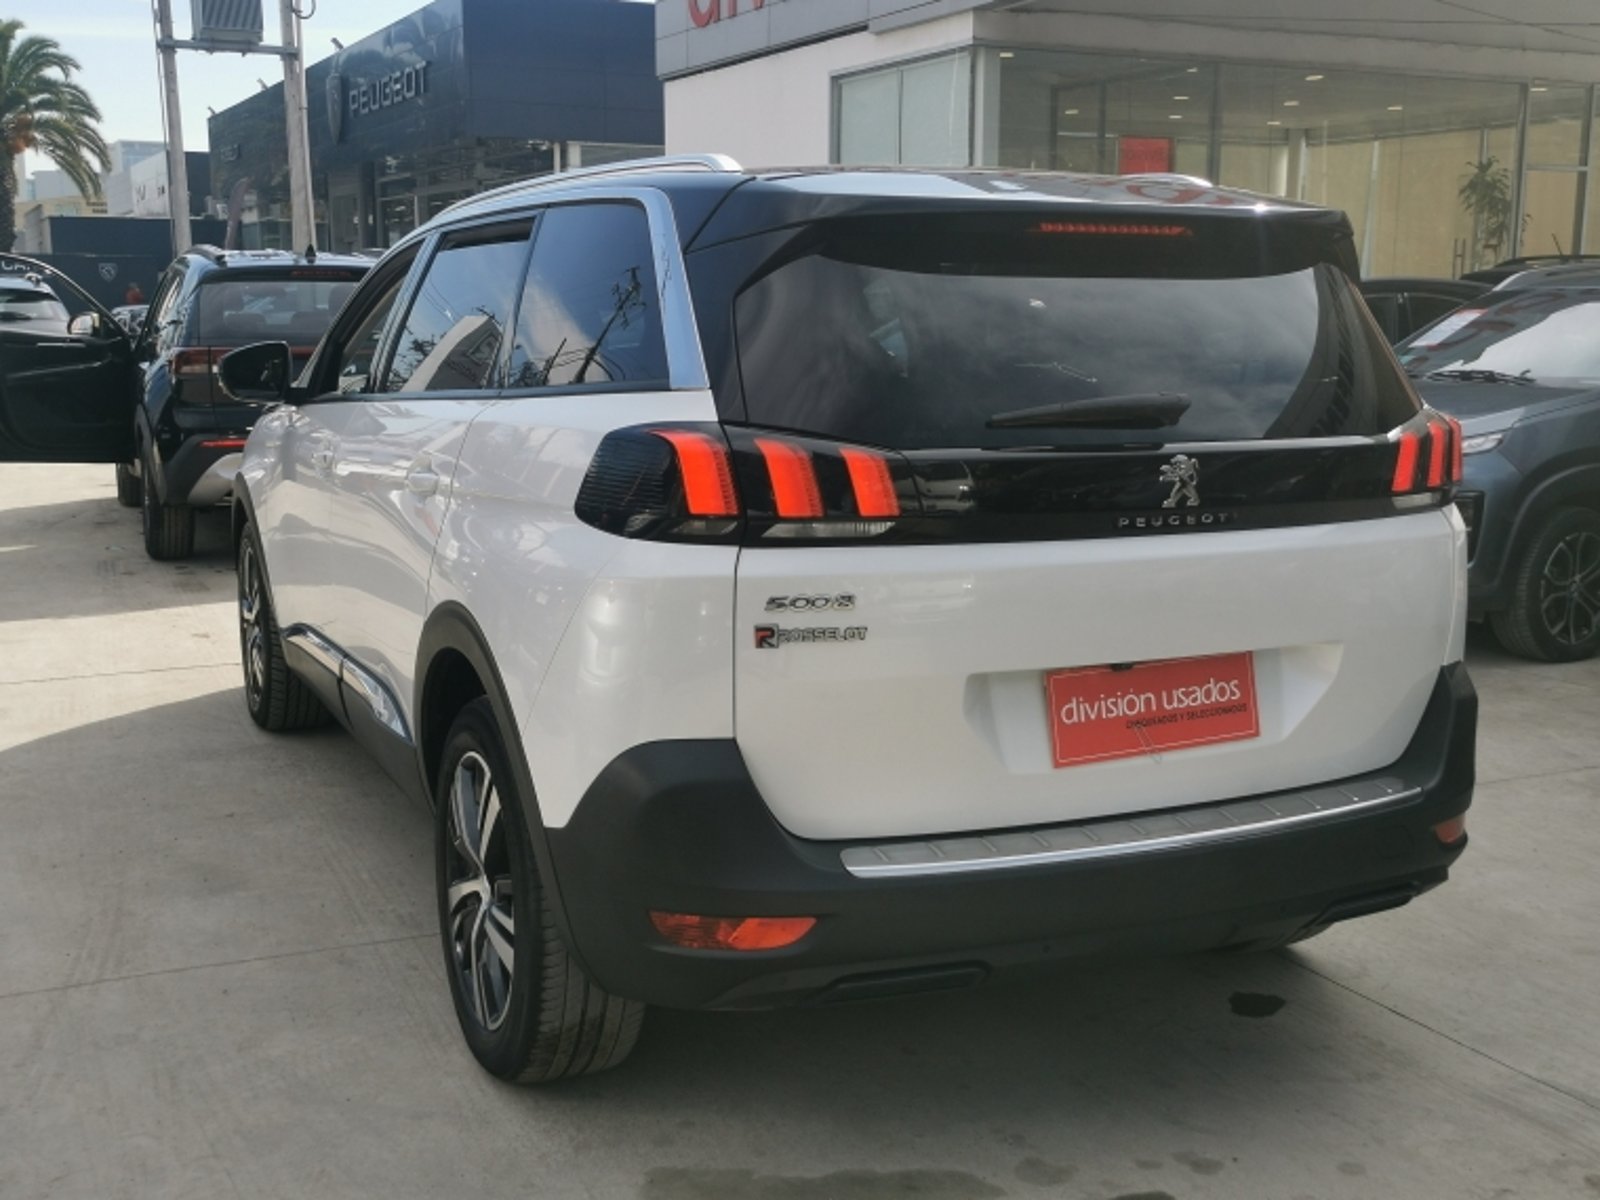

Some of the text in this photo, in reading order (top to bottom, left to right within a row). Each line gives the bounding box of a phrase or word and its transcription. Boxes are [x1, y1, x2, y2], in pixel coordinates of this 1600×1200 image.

[349, 60, 426, 117] PEUGEOT
[1119, 512, 1228, 528] PEUGEOT
[763, 594, 856, 612] 5008
[1060, 678, 1241, 724] división usados
